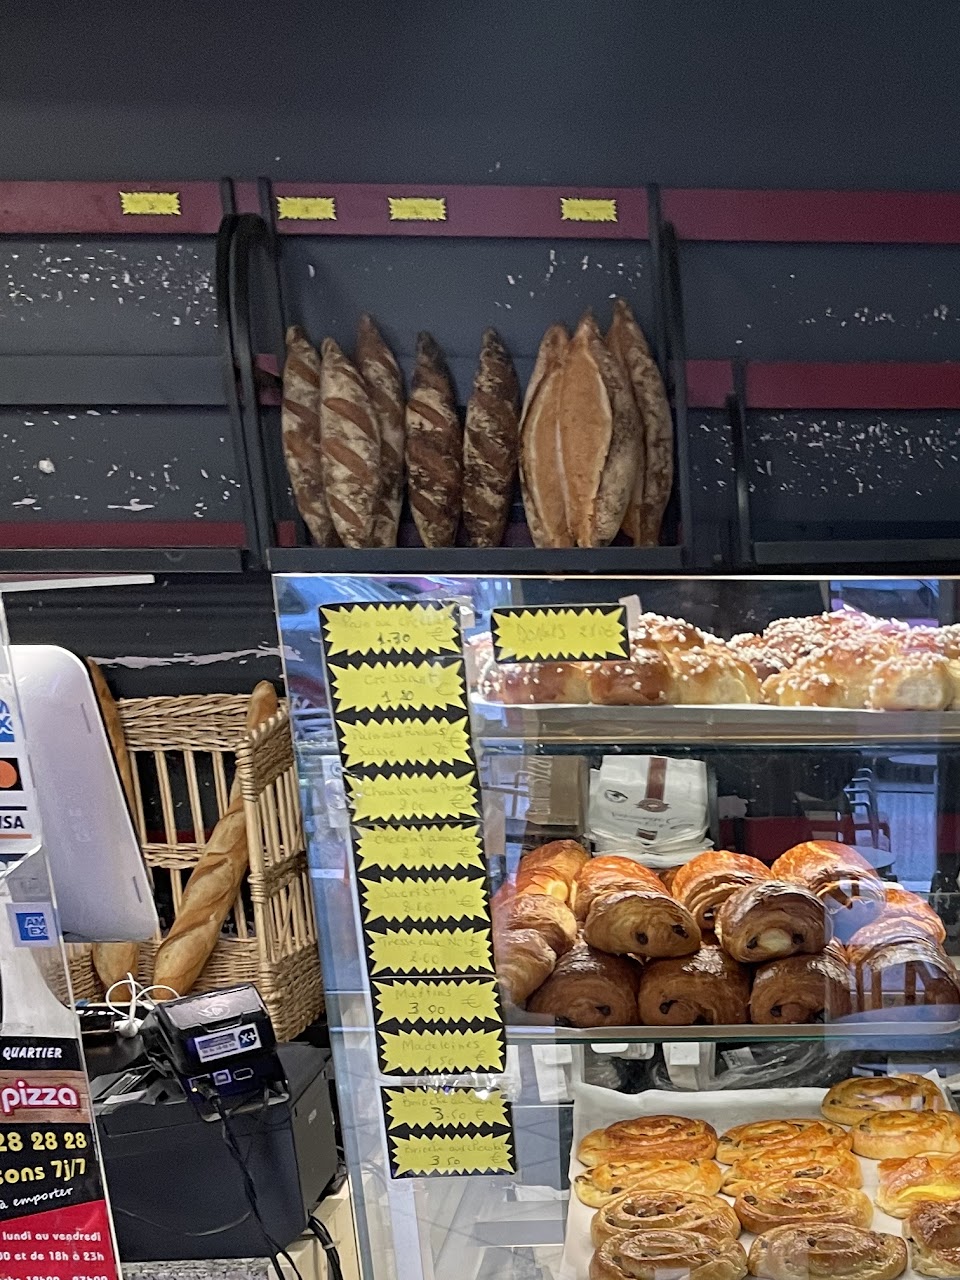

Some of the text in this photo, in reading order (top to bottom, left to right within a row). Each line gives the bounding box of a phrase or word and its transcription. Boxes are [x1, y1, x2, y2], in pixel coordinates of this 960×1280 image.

[2, 1046, 63, 1060] QUARTIER
[2, 1081, 77, 1113] pizza
[30, 1131, 58, 1151] 28
[64, 1131, 87, 1149] 28
[50, 1158, 86, 1182] 7j/7
[13, 1186, 74, 1207] emporter
[2, 1231, 102, 1242] lundi au vendredi
[14, 1252, 27, 1261] et
[30, 1252, 45, 1261] de
[49, 1251, 69, 1261] 18h
[83, 1251, 105, 1261] 23h
